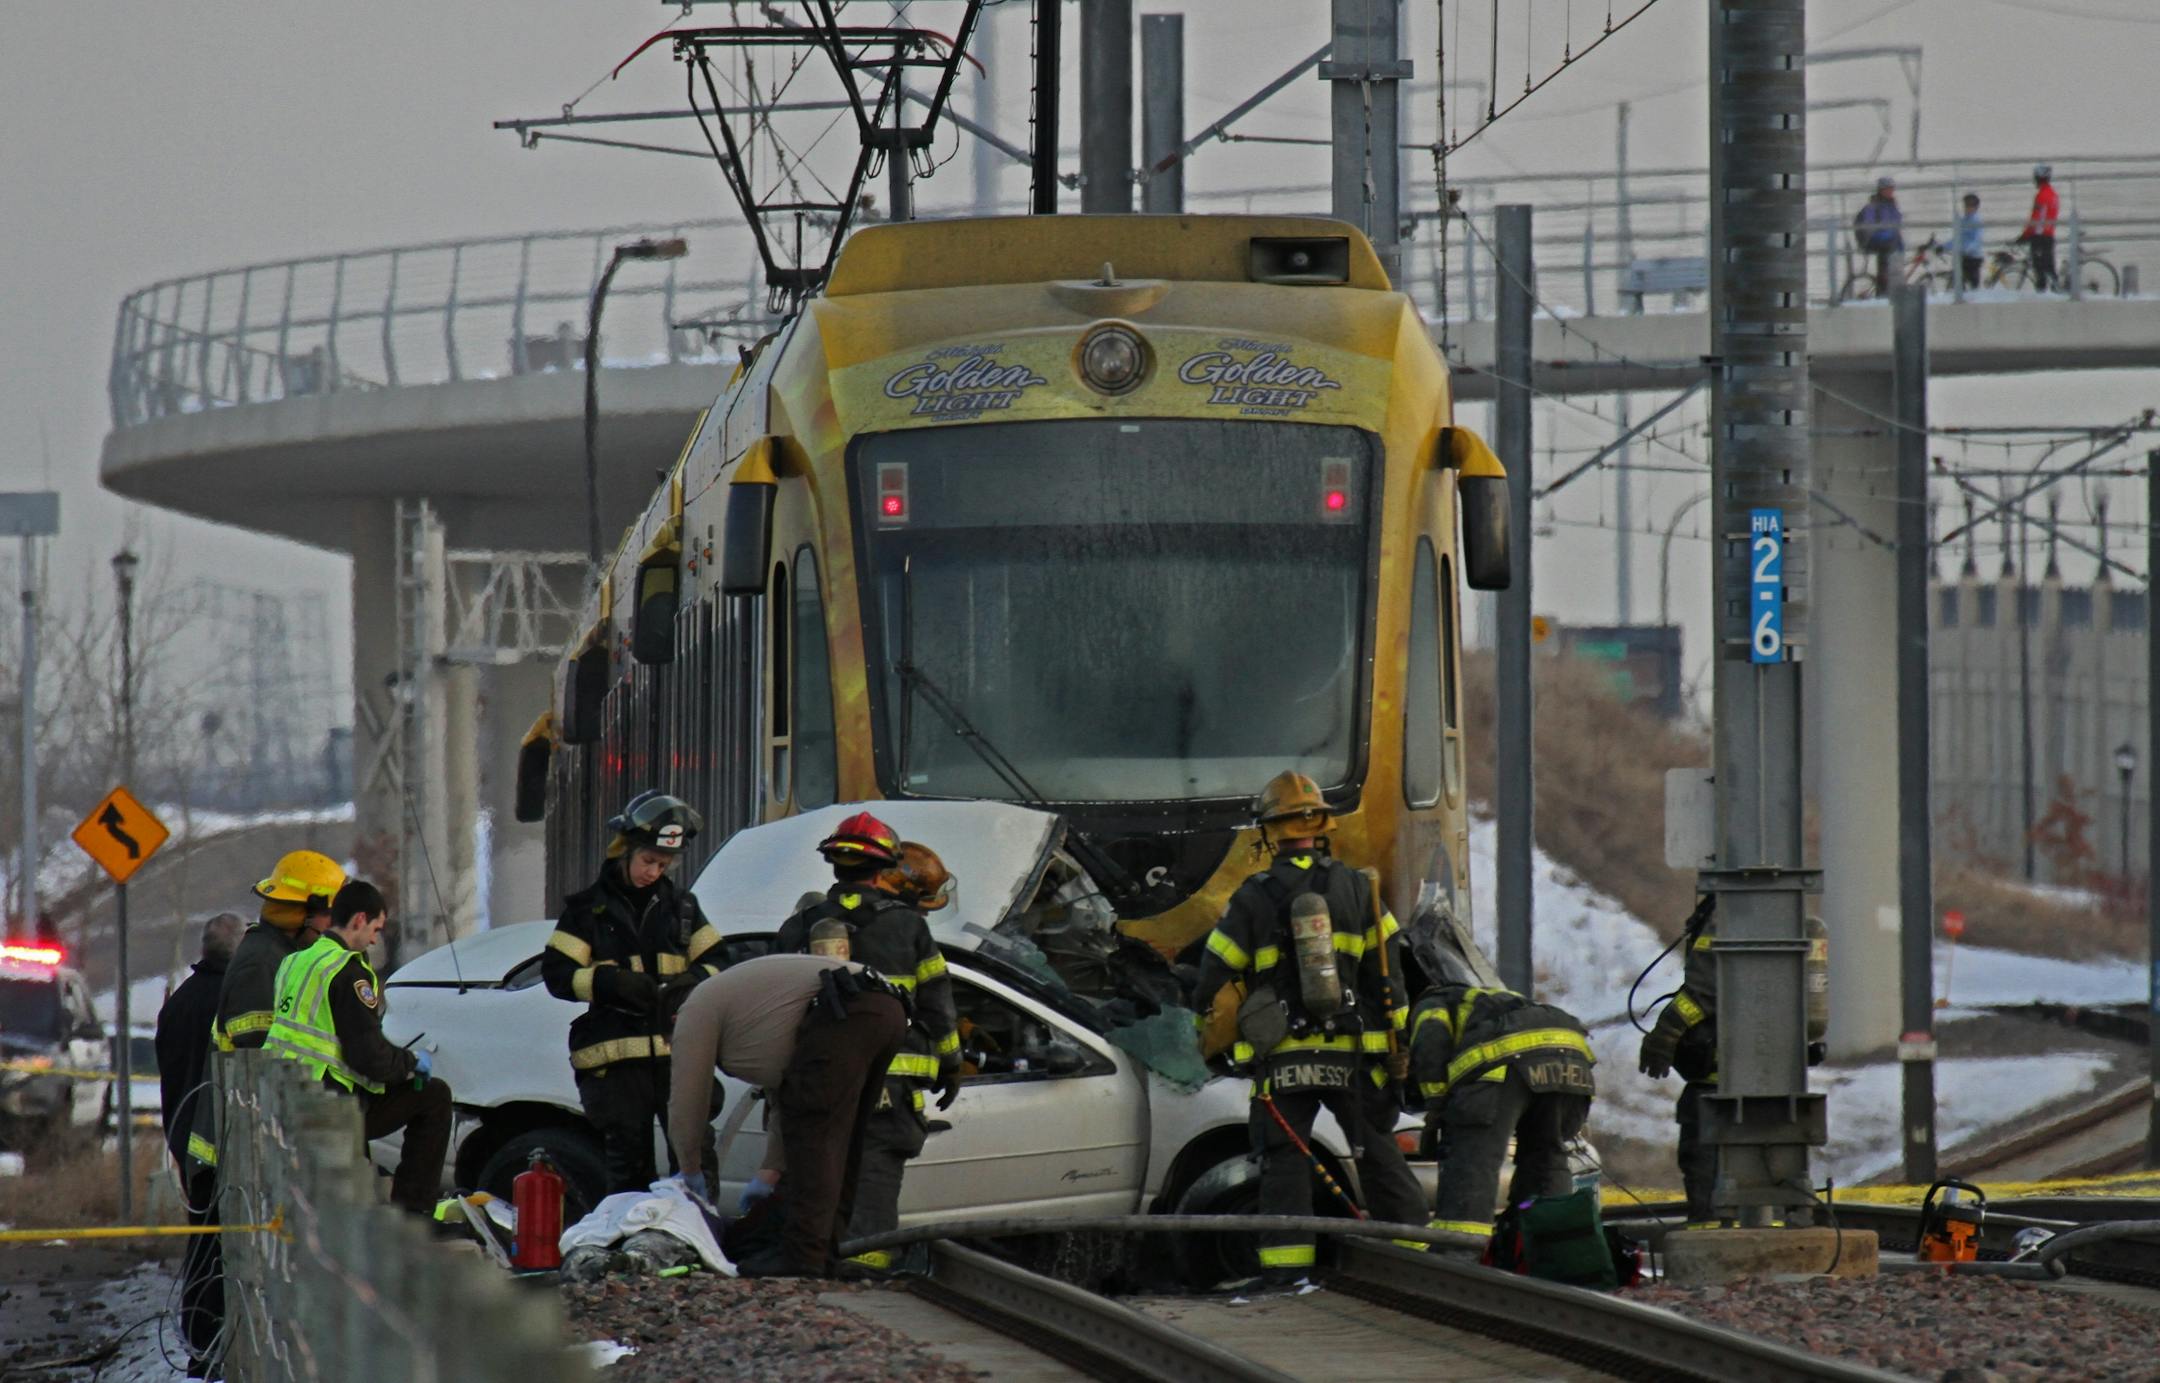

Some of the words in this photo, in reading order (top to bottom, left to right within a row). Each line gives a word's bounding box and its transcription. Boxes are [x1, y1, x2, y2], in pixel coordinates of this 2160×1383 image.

[885, 355, 1047, 398] Golden
[1179, 352, 1342, 389] Golden
[911, 390, 1022, 416] LIGHT
[1208, 385, 1317, 407] LIGHT
[1752, 516, 1779, 532] HIA
[1274, 1064, 1354, 1088] HENNESSY
